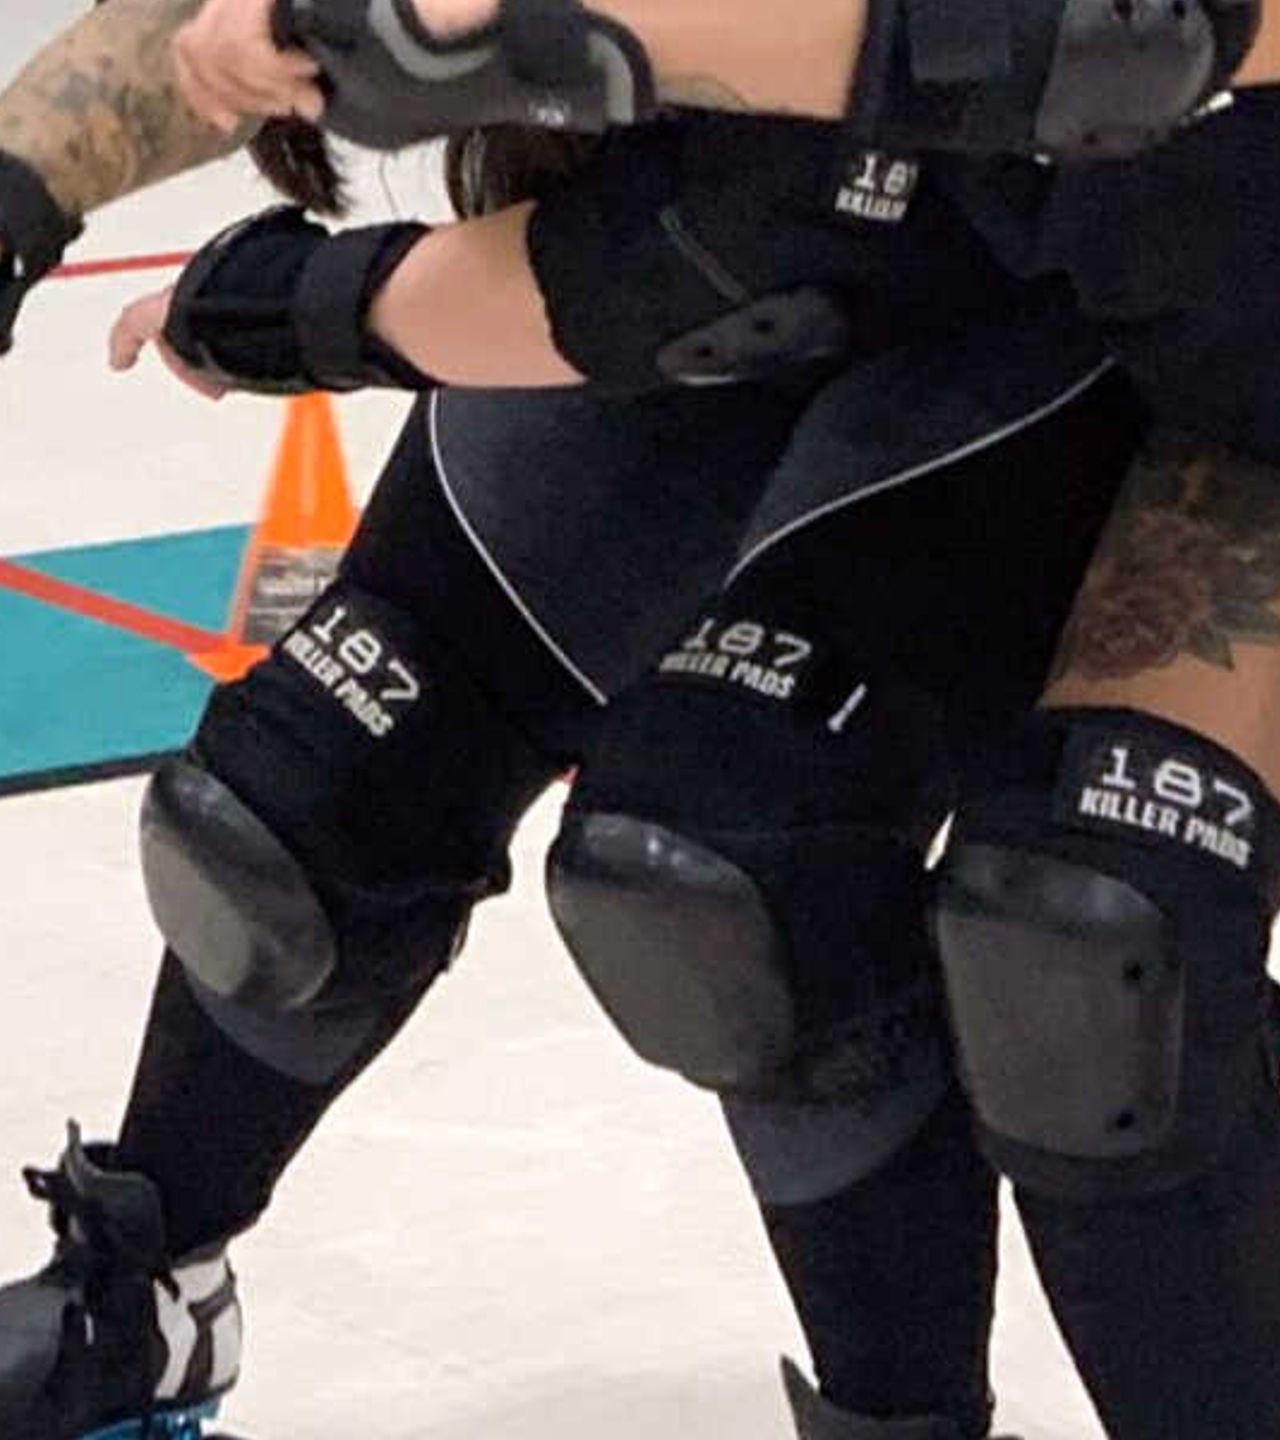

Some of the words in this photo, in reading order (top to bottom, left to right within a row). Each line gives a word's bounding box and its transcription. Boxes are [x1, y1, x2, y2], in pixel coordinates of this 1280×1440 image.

[311, 606, 419, 700] 187
[683, 617, 812, 667] 187
[729, 660, 795, 698] PADS
[1078, 786, 1179, 837] KILLER
[1101, 747, 1255, 826] 187
